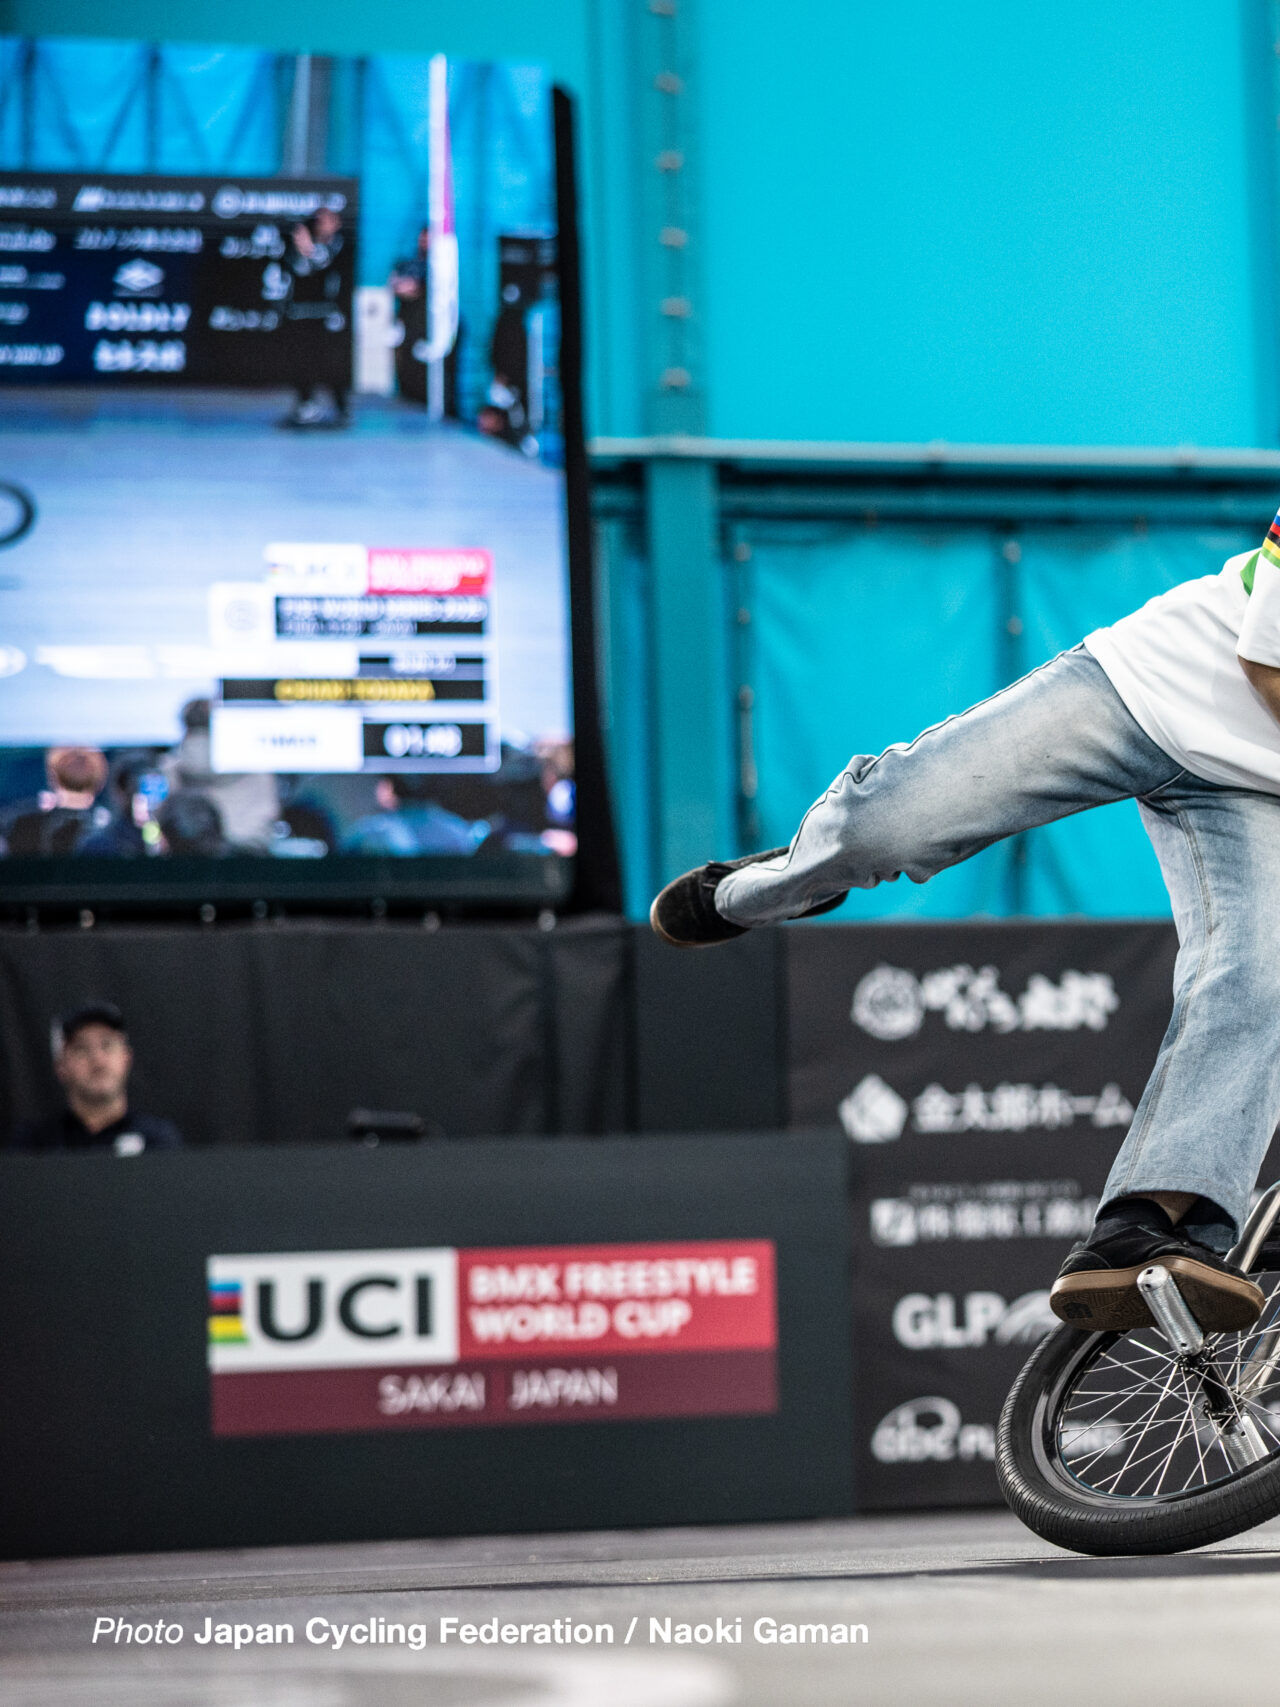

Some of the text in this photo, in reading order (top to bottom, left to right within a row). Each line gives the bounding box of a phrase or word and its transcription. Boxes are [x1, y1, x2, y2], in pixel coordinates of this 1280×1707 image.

[469, 1257, 757, 1301] BMX FREESTYLE
[255, 1271, 434, 1342] UCI
[469, 1300, 693, 1342] WORLD CUP
[893, 1290, 1004, 1350] GLP
[378, 1366, 619, 1415] SAKAI JAPAN
